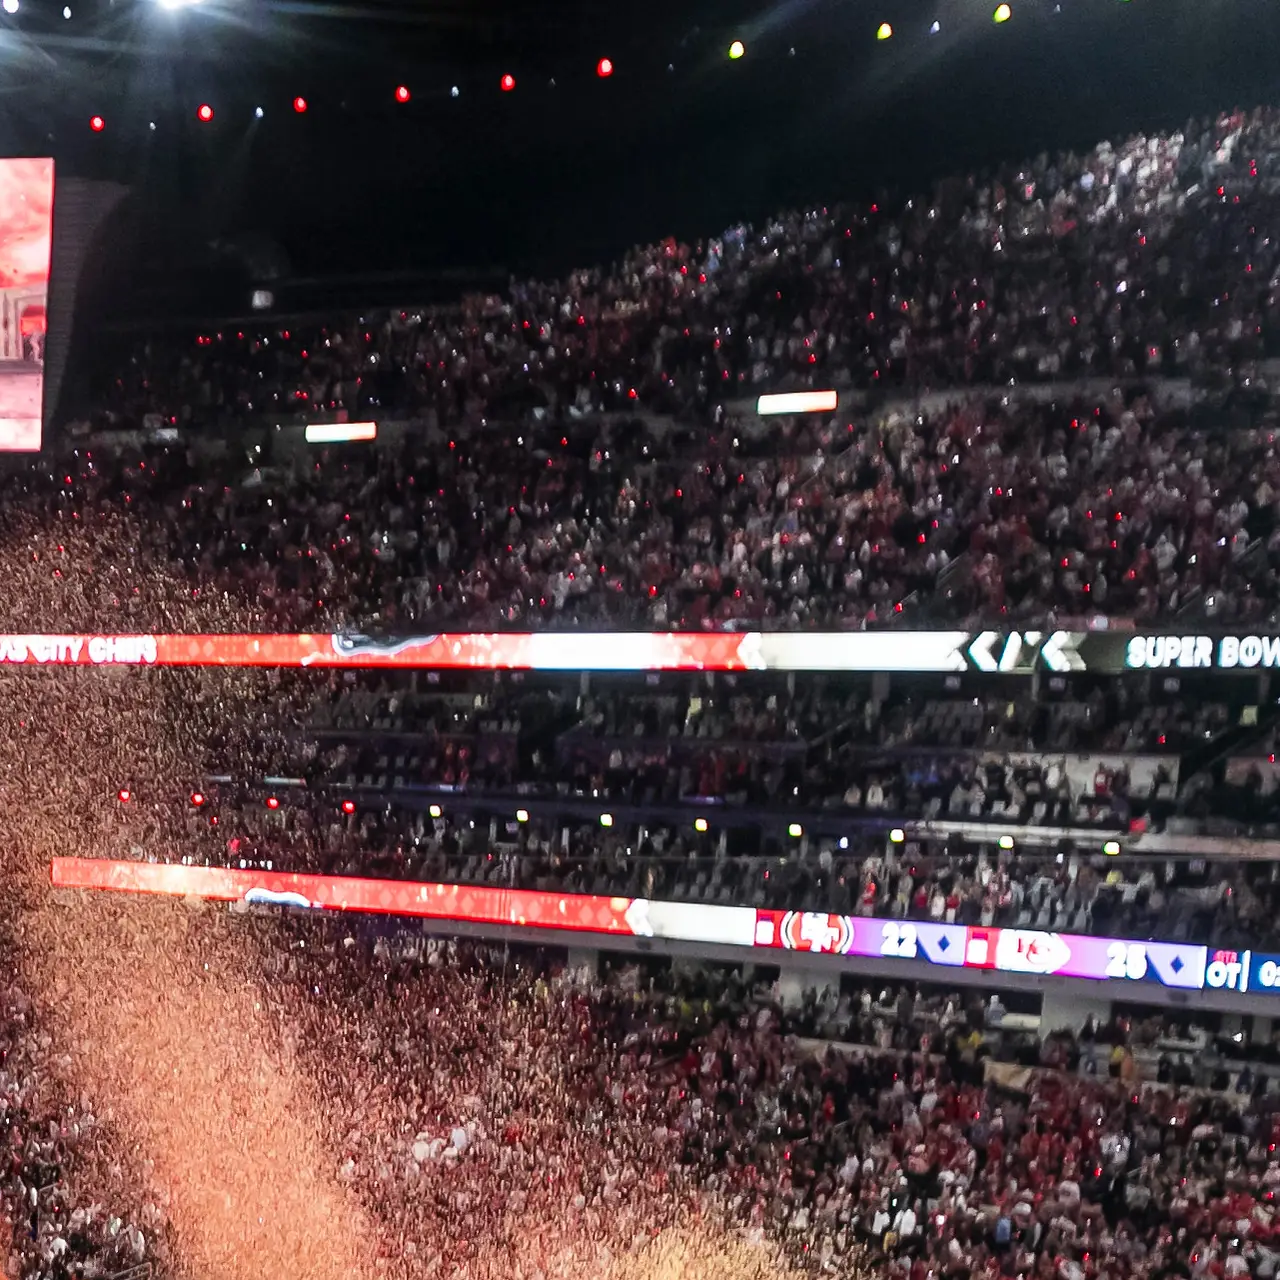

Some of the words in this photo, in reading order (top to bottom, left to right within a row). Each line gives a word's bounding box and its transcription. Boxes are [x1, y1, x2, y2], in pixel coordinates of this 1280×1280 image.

[1127, 636, 1213, 668] SUPER
[880, 921, 917, 958] 22
[1206, 961, 1243, 989] OT
